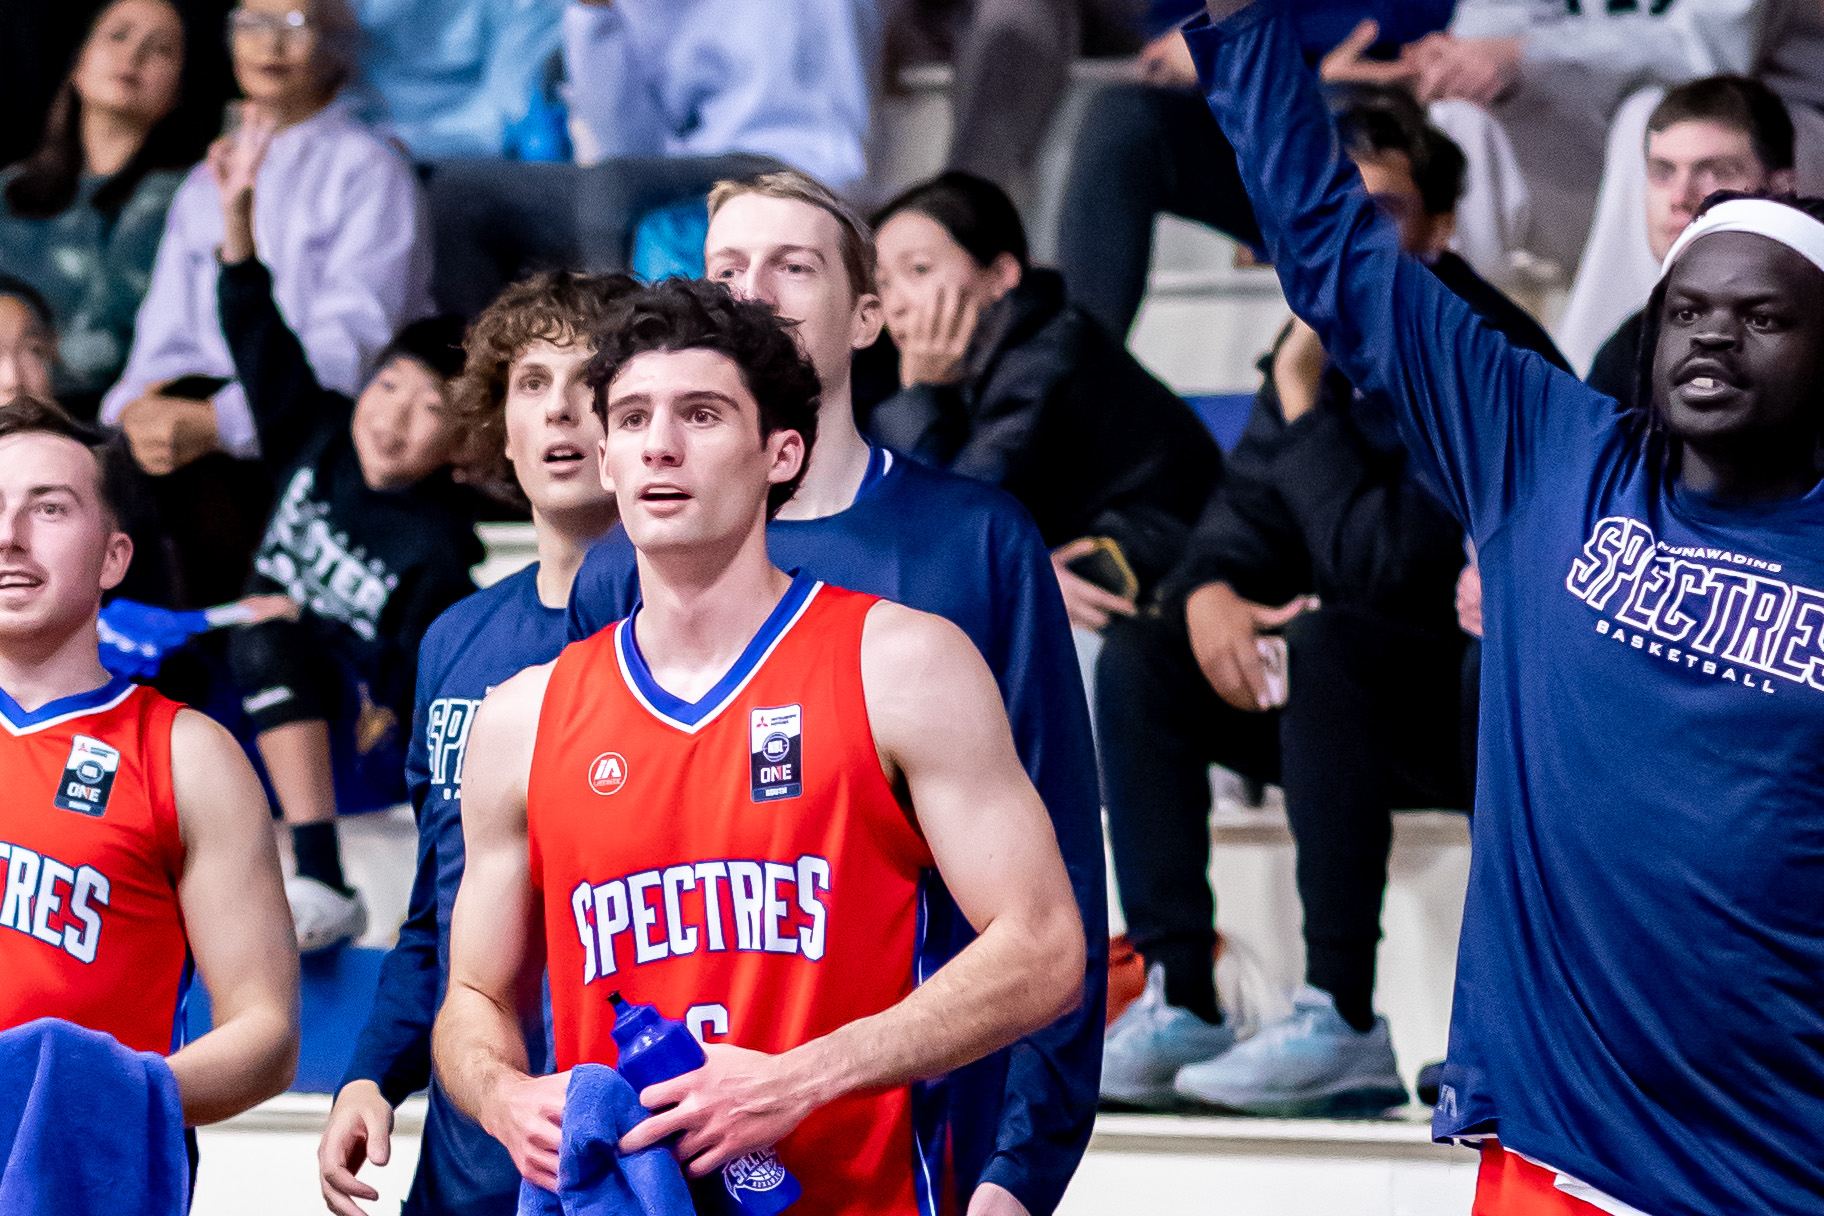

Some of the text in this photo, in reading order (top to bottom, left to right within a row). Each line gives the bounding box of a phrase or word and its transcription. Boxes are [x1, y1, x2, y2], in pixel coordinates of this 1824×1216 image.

[1657, 541, 1782, 573] NUNAWADING
[1595, 619, 1775, 694] BASKETBALL
[760, 763, 792, 784] ONE
[66, 781, 102, 803] ONE
[572, 855, 831, 986] SPECTRES
